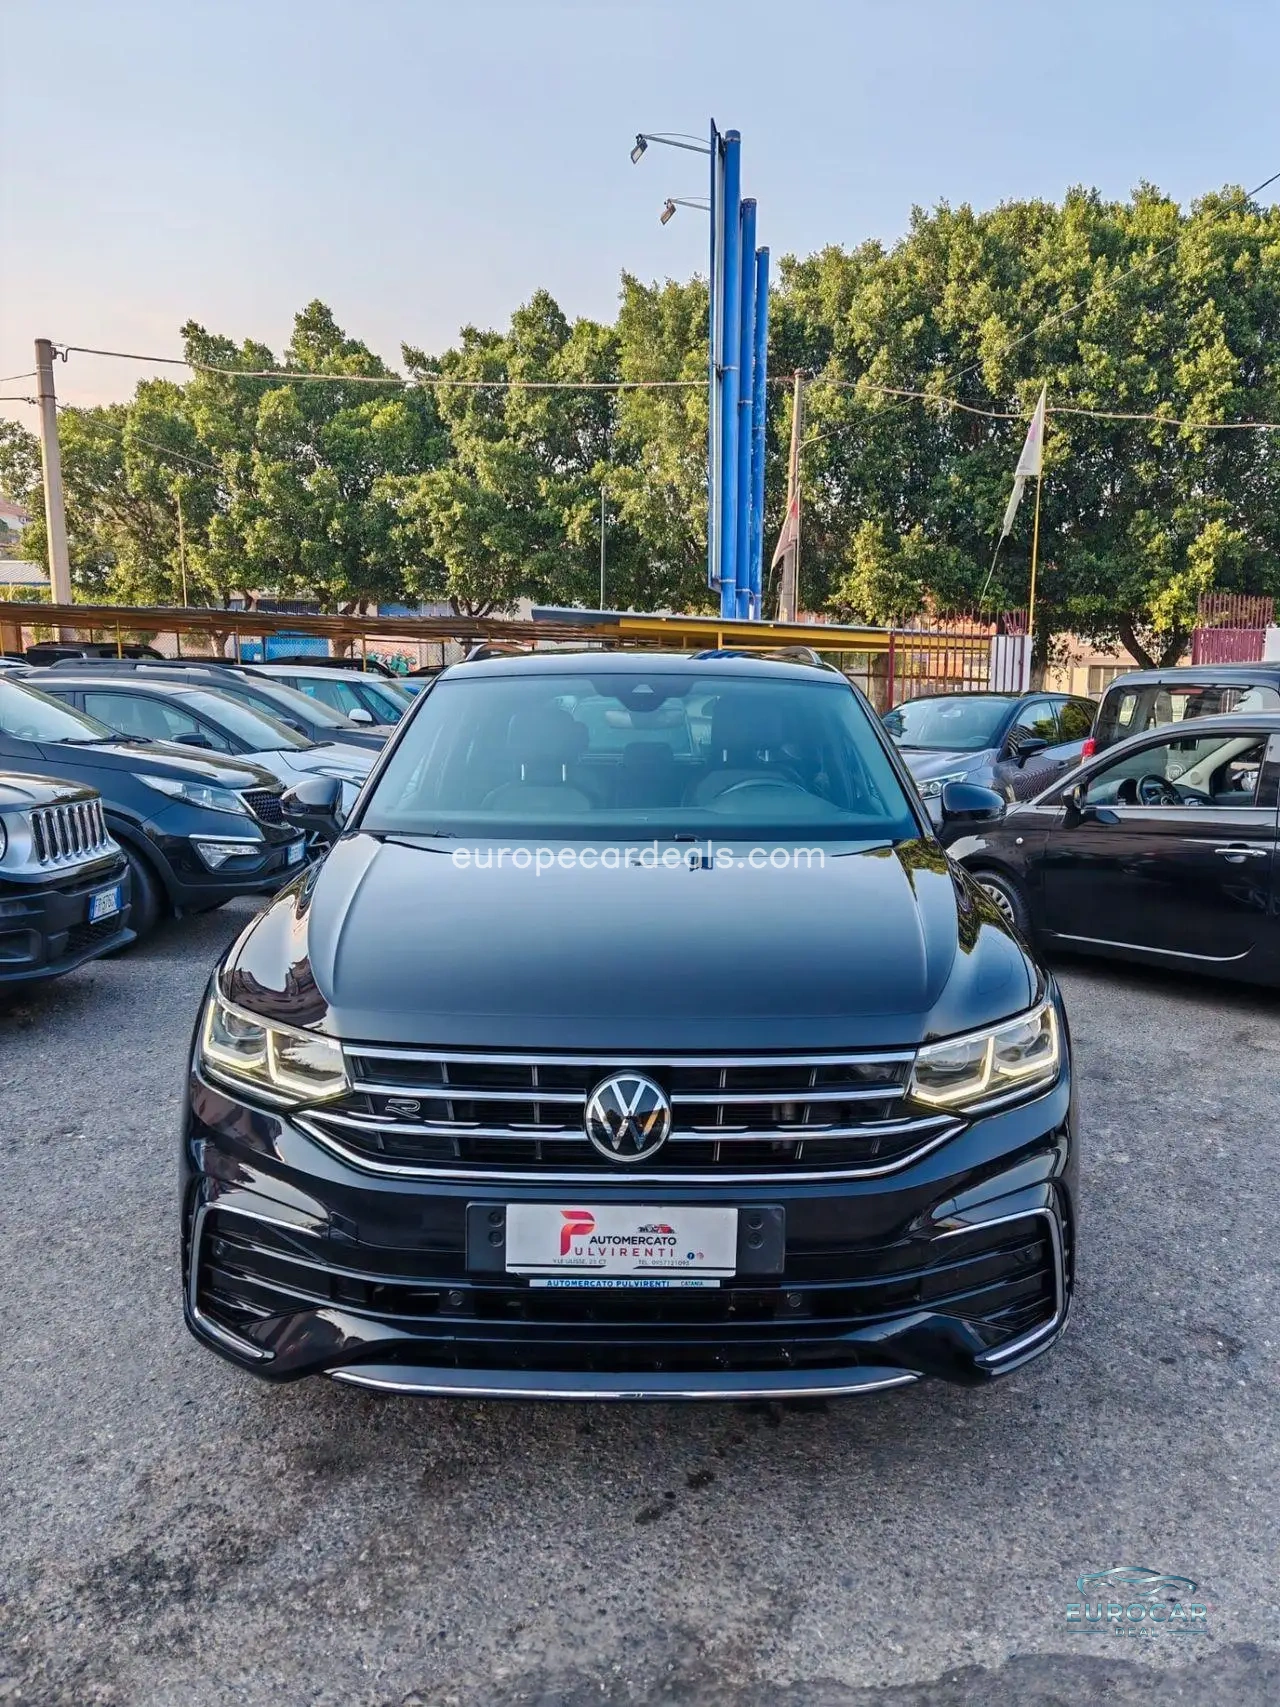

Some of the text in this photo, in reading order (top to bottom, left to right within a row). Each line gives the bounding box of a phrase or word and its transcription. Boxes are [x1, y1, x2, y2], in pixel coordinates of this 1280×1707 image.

[589, 1235, 677, 1246] AUTOMERCATO
[547, 1280, 613, 1288] AUTOMERCATO
[616, 1280, 670, 1288] PULVIRENTI
